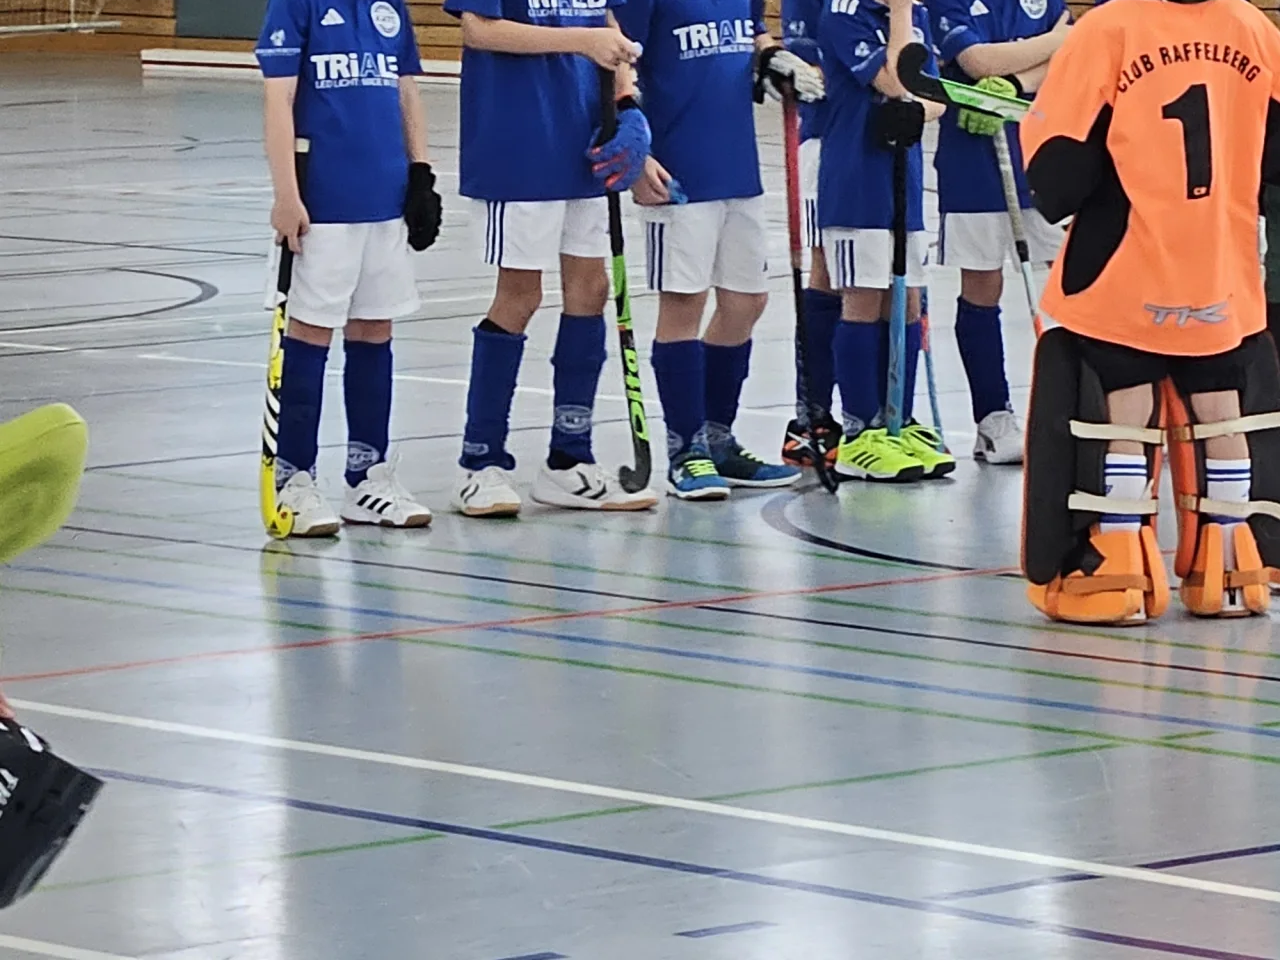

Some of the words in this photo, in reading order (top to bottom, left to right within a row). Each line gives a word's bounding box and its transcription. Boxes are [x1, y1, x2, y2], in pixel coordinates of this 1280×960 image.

[672, 19, 755, 51] TRiALE
[310, 52, 399, 80] TRiALE
[1117, 54, 1155, 93] CLUB
[1159, 42, 1261, 83] RAFFELBERG
[1161, 83, 1212, 200] 1
